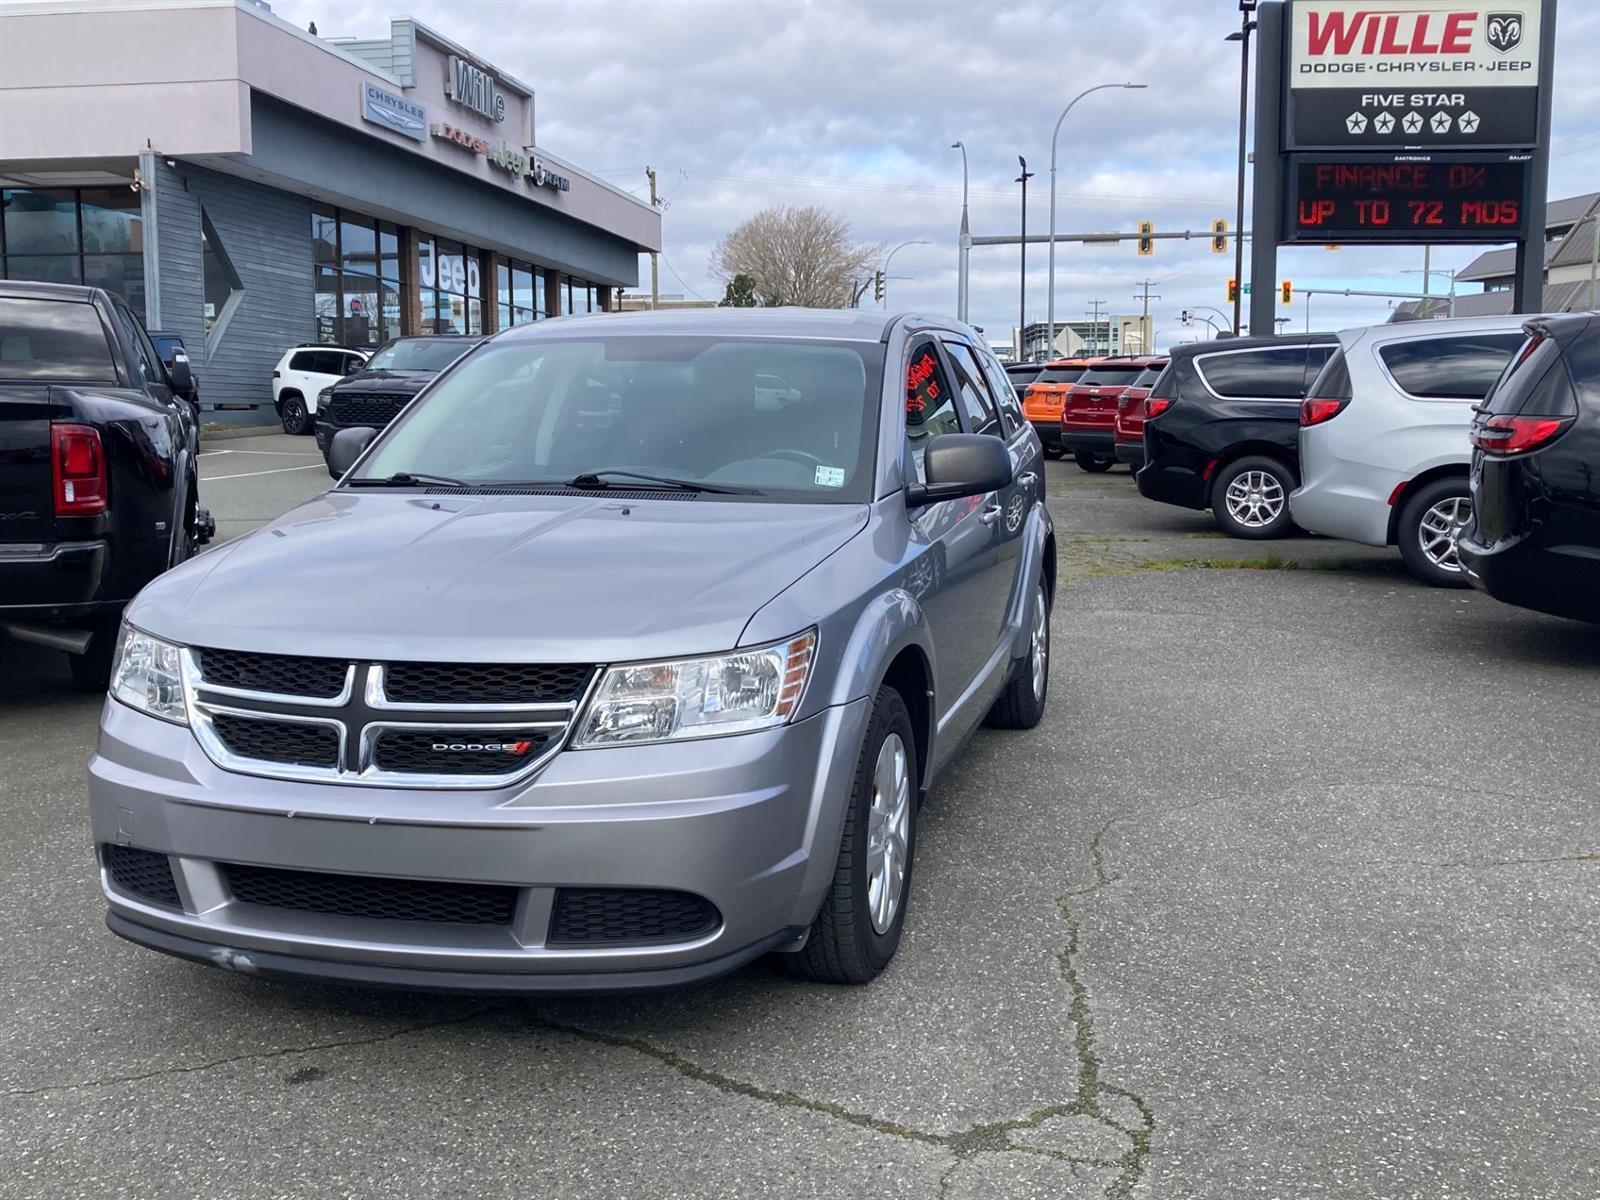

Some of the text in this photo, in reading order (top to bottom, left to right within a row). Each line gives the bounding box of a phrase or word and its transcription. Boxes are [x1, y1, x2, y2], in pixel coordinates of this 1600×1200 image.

[1307, 10, 1478, 55] WILLE
[1300, 60, 1532, 74] DODGE CHRYSLER JEEP
[449, 55, 505, 123] Wille
[1361, 93, 1465, 107] FIVE STAR
[367, 87, 426, 120] CHRYSLER
[443, 122, 491, 155] DODGE
[544, 169, 570, 192] RAM
[1316, 164, 1486, 189] FINANCE 0%
[1299, 200, 1519, 224] UP TO 72 MOS
[420, 239, 480, 298] Jeep
[432, 743, 518, 752] DODGE
